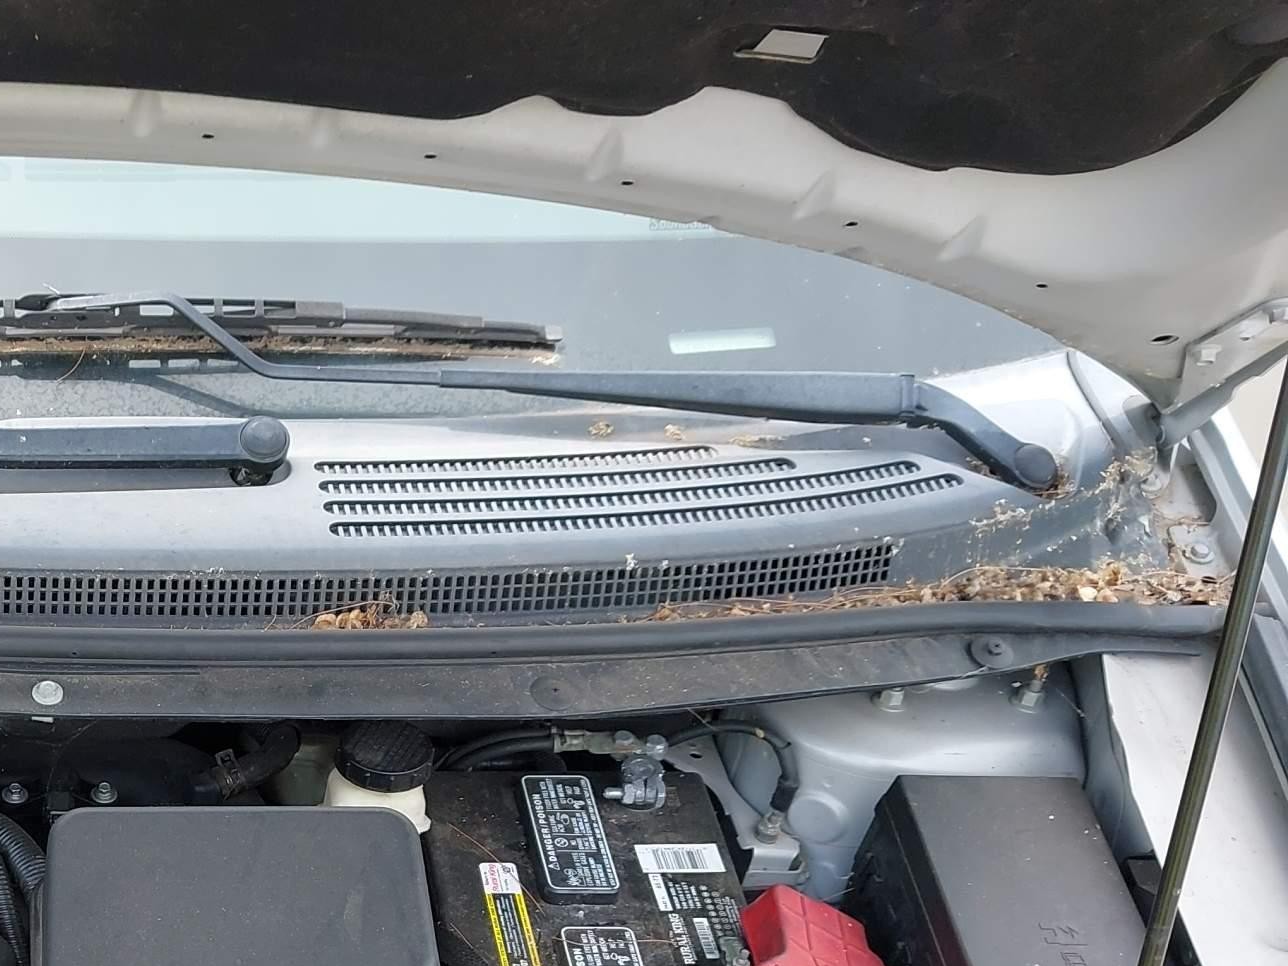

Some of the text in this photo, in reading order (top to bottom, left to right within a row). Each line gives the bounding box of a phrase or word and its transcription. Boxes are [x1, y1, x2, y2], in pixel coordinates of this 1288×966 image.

[532, 793, 557, 861] DANGER/POISON
[666, 912, 685, 933] KING
[674, 934, 696, 964] RURAL
